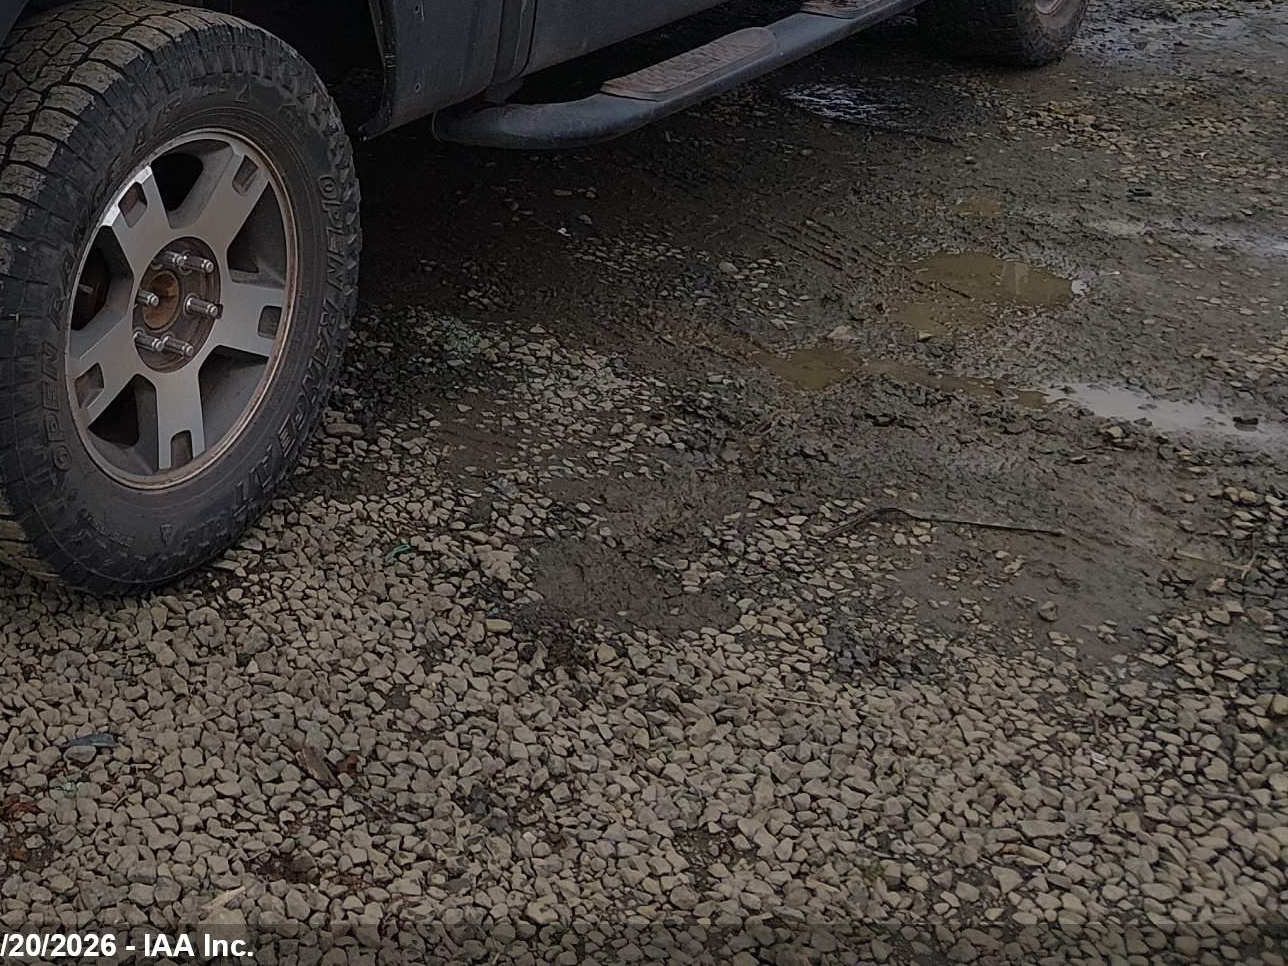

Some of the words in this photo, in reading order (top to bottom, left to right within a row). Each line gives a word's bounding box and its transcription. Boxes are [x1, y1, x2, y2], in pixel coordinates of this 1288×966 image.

[316, 172, 345, 292] OPEN
[41, 340, 74, 472] OPEN
[274, 296, 341, 459] RANGE
